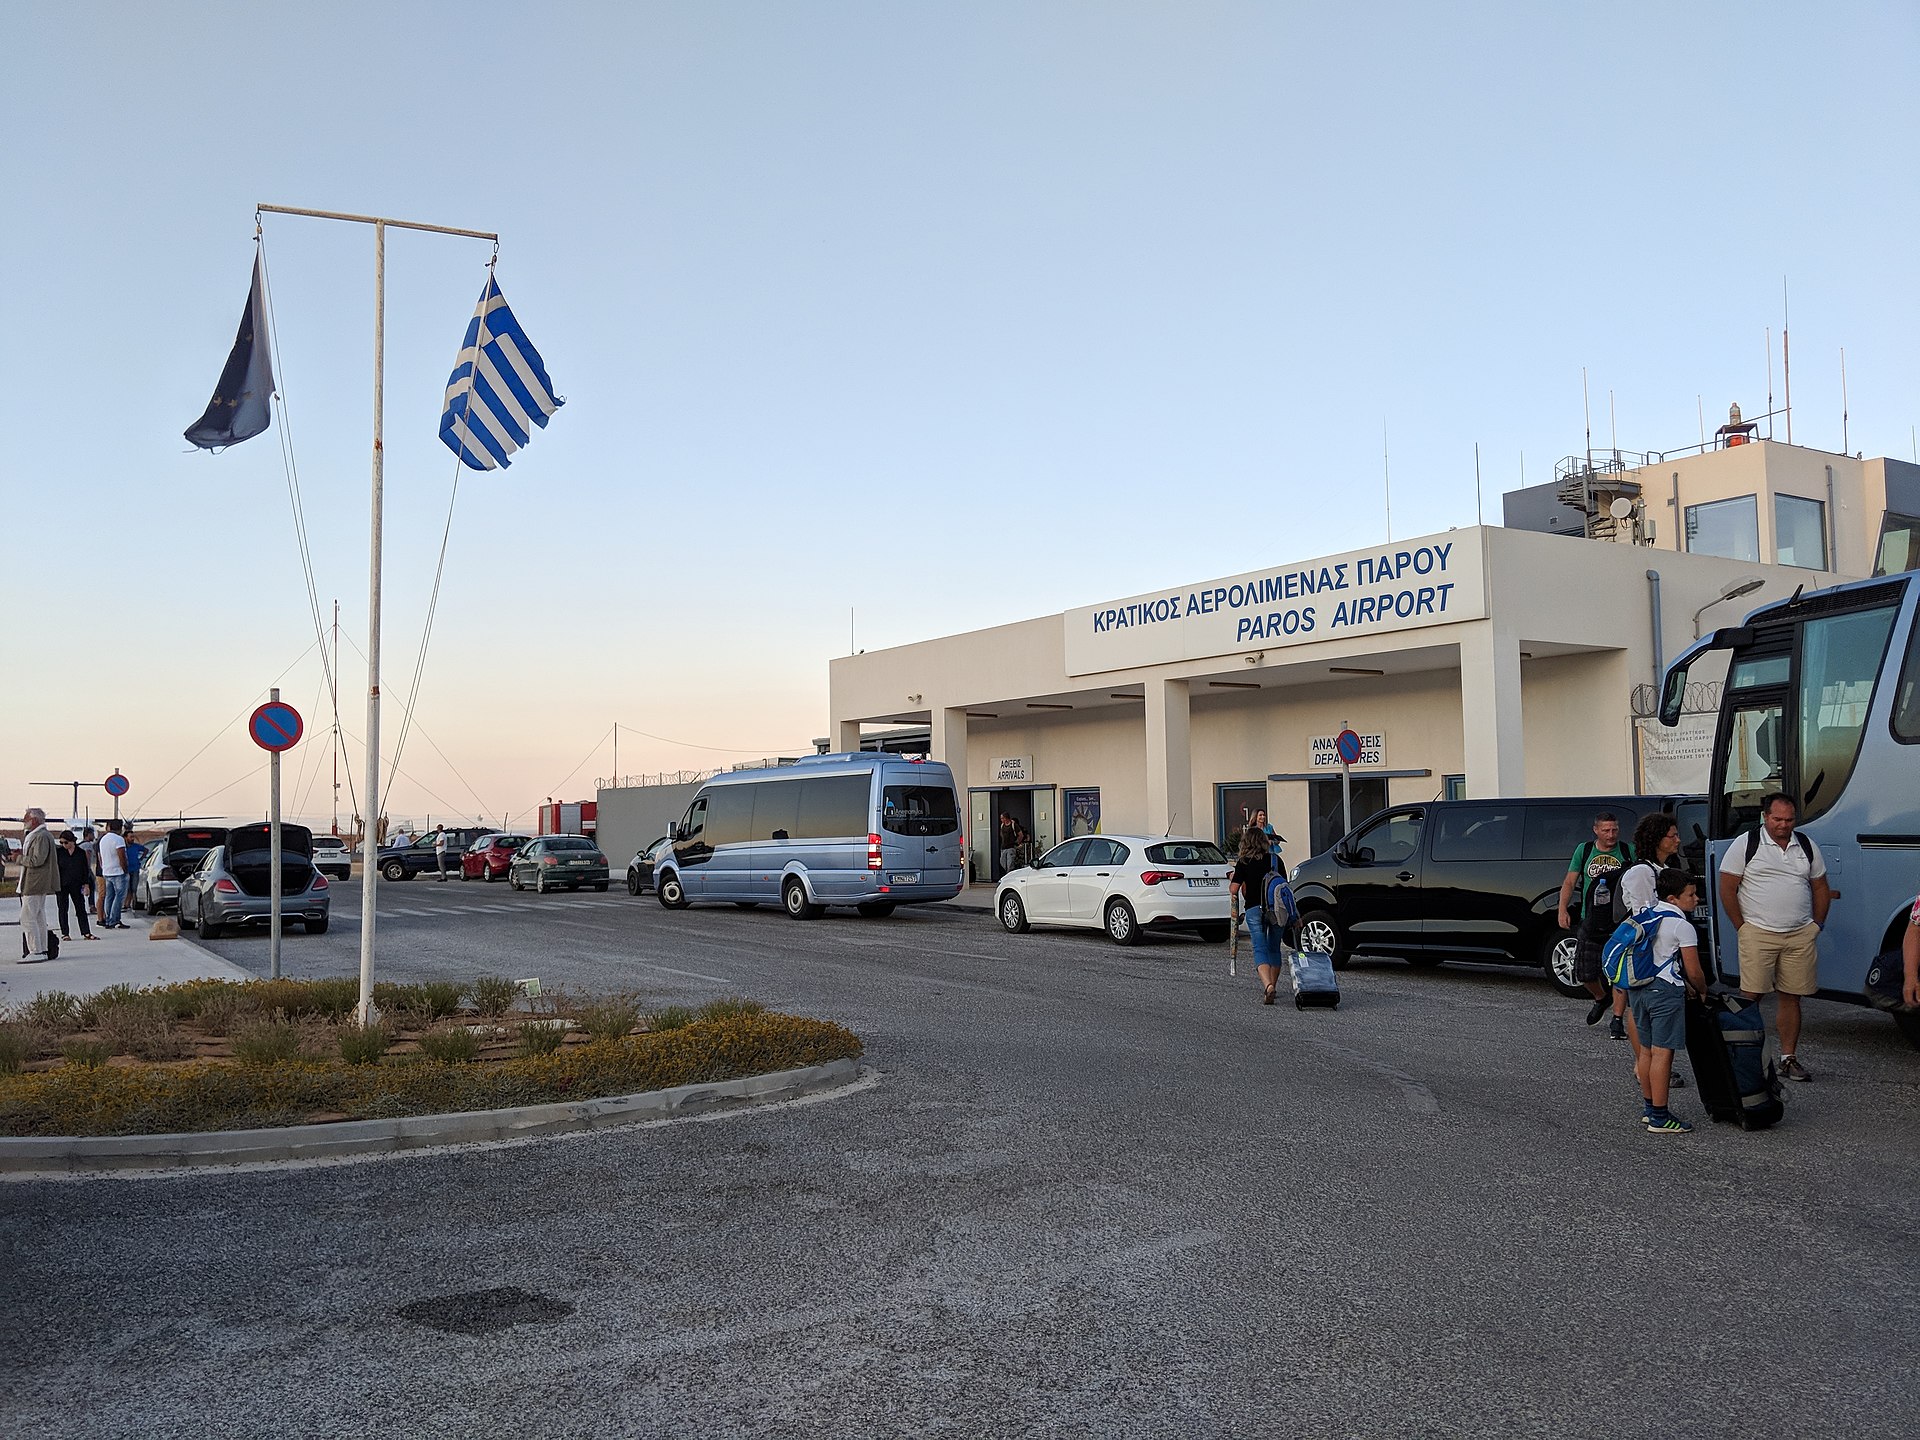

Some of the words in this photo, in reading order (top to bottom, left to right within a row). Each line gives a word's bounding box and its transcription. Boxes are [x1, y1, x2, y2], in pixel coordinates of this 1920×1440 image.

[1093, 596, 1181, 634] ΚΡΑΤΙΚΟΣ
[1185, 564, 1349, 617] ΑΕΡΟΛΙΜΕΝΑΣ
[1356, 543, 1453, 586] ΠΑΡΟΥ
[1236, 607, 1316, 642] PAROS
[1331, 583, 1454, 628] AIRPORT
[1312, 735, 1382, 751] ΑΝΑΧΣΕΙΣ
[1314, 751, 1380, 765] DEPARES
[997, 770, 1025, 780] ARRIVALS
